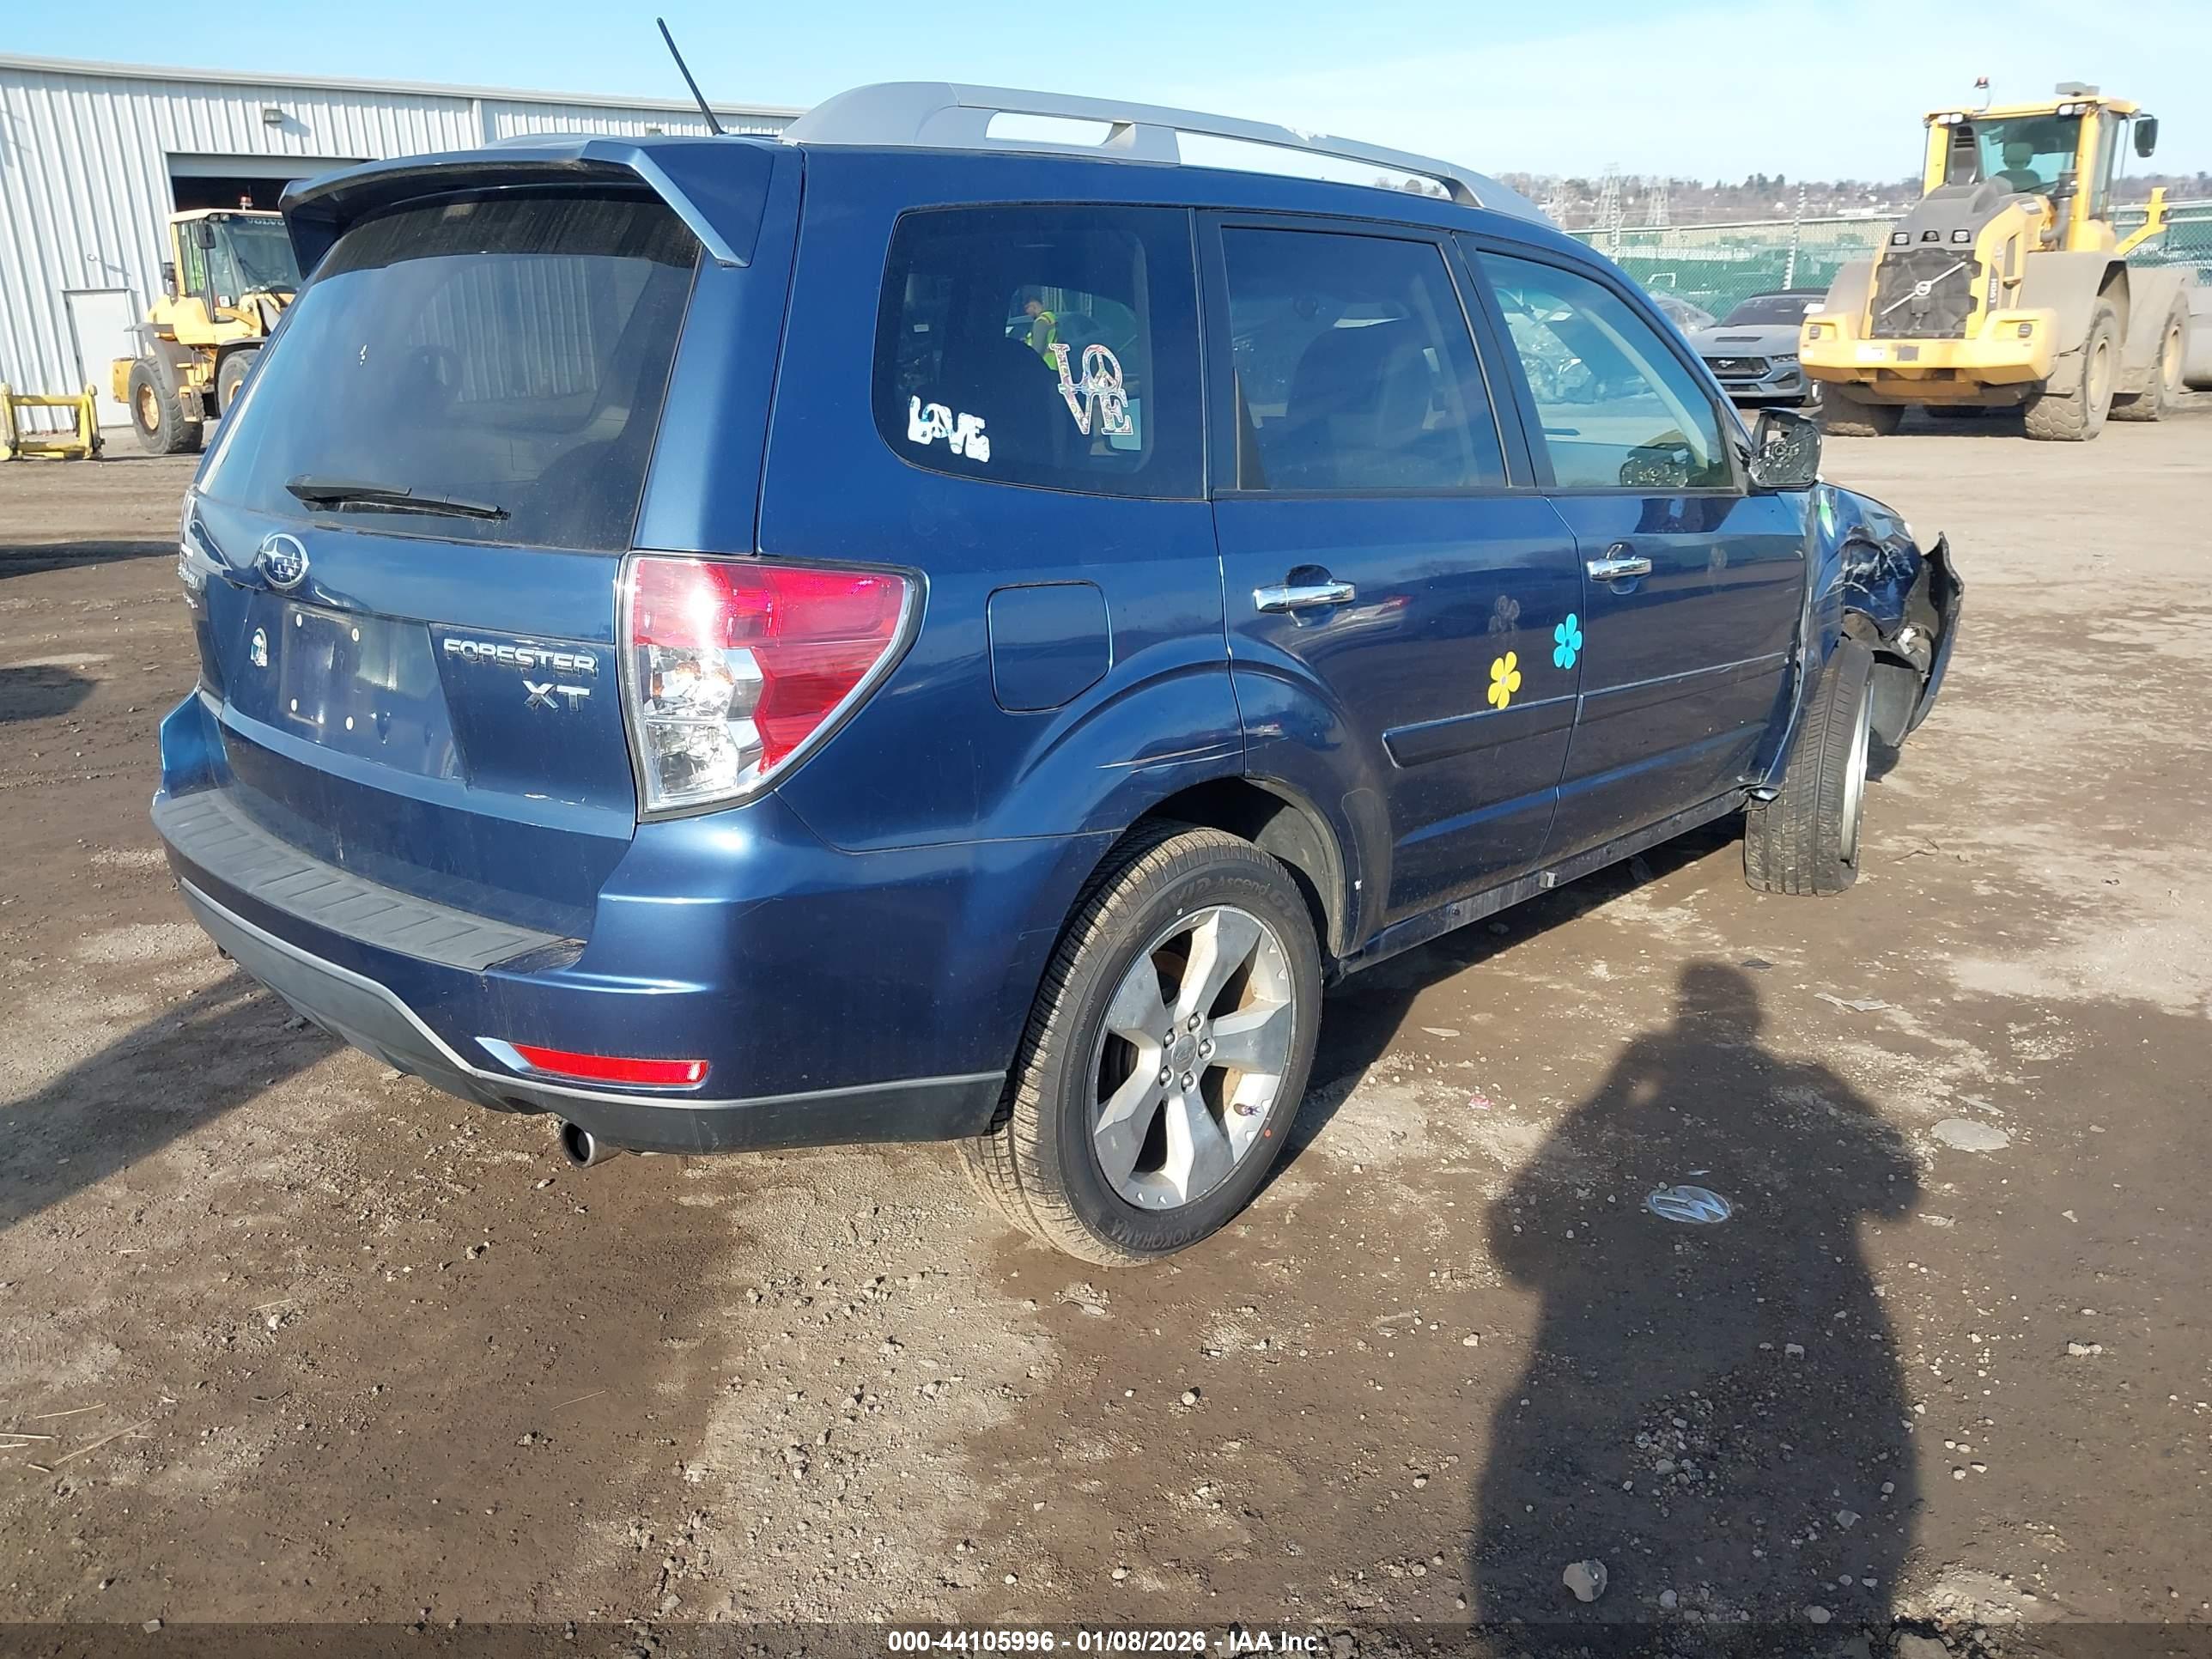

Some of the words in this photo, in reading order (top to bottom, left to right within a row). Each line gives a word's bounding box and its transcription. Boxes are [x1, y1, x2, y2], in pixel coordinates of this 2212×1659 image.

[246, 217, 286, 227] VOLVO
[443, 638, 600, 679] FORESTER
[522, 680, 592, 712] XT
[1215, 875, 1271, 896] Ascend
[1110, 1219, 1193, 1249] YOKOHAMA
